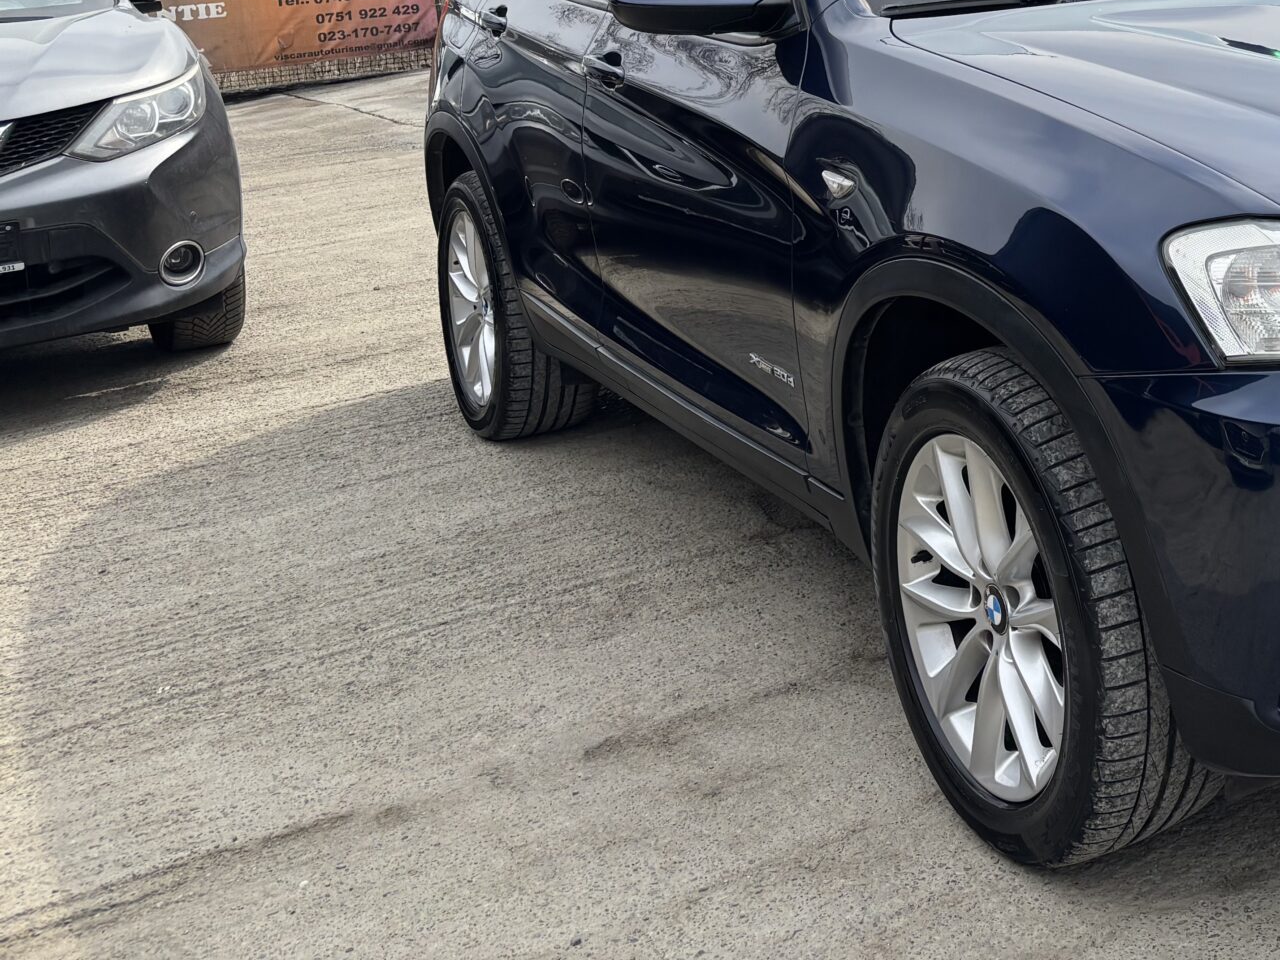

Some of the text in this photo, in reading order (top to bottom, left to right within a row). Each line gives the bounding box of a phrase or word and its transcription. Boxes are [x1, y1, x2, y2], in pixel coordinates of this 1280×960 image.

[316, 4, 420, 25] 0751 922 429
[317, 22, 420, 43] 023-170-7497
